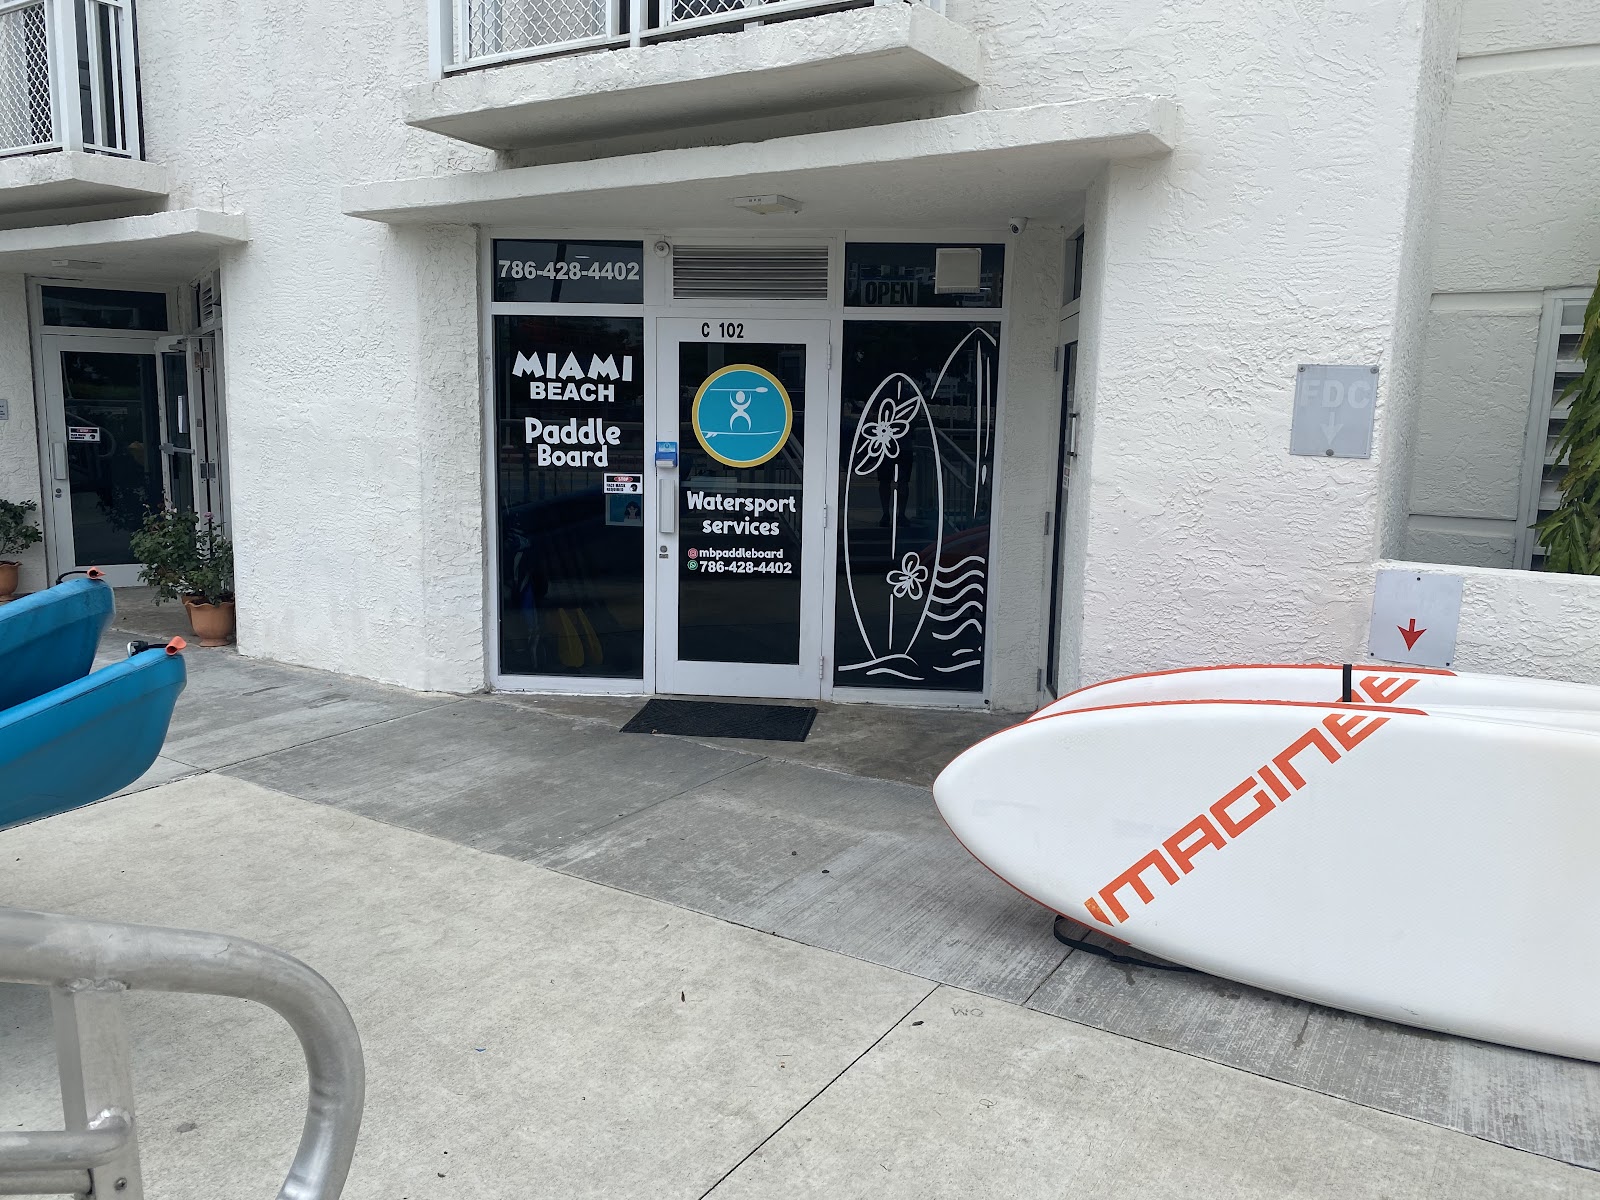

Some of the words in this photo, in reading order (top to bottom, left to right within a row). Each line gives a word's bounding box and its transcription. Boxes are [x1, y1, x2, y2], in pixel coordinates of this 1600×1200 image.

[498, 259, 640, 281] 786-428-4402
[865, 281, 914, 305] OPEN
[701, 322, 711, 338] C
[719, 322, 744, 339] 102
[512, 350, 633, 382] MIAMI
[529, 381, 615, 402] BEACH
[1298, 379, 1373, 409] FDC
[524, 416, 621, 446] Paddle
[537, 445, 609, 468] Board
[686, 490, 797, 517] Watersport
[702, 516, 780, 536] services
[699, 547, 784, 560] mbpaddleboard
[699, 560, 793, 574] 786-428-4402
[1083, 712, 1392, 928] IMAGINE
